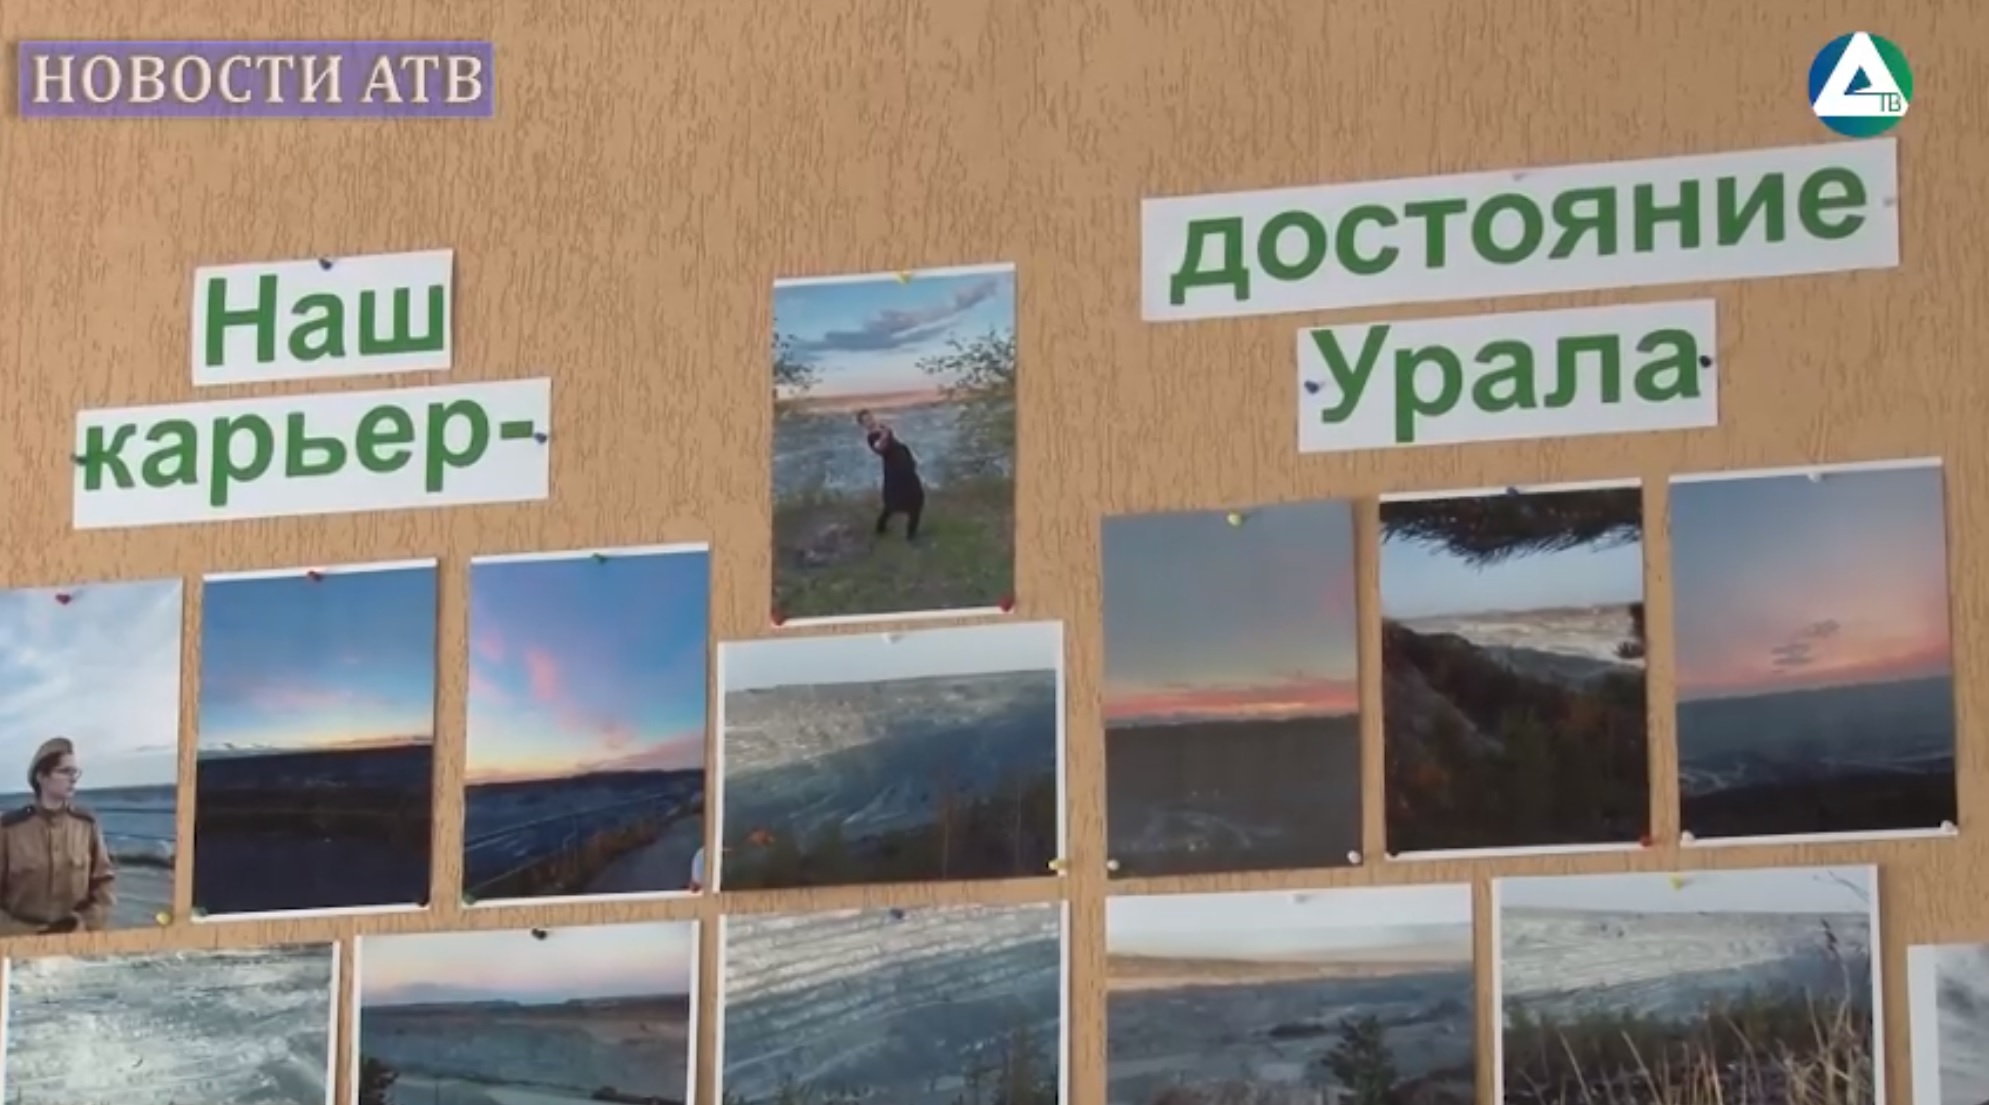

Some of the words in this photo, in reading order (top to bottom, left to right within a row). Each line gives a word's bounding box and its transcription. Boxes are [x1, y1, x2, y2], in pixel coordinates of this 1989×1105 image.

[1169, 163, 1868, 305] достояние
[205, 274, 445, 367] Наш
[1310, 323, 1701, 443] Урала
[82, 399, 534, 507] карьер-
